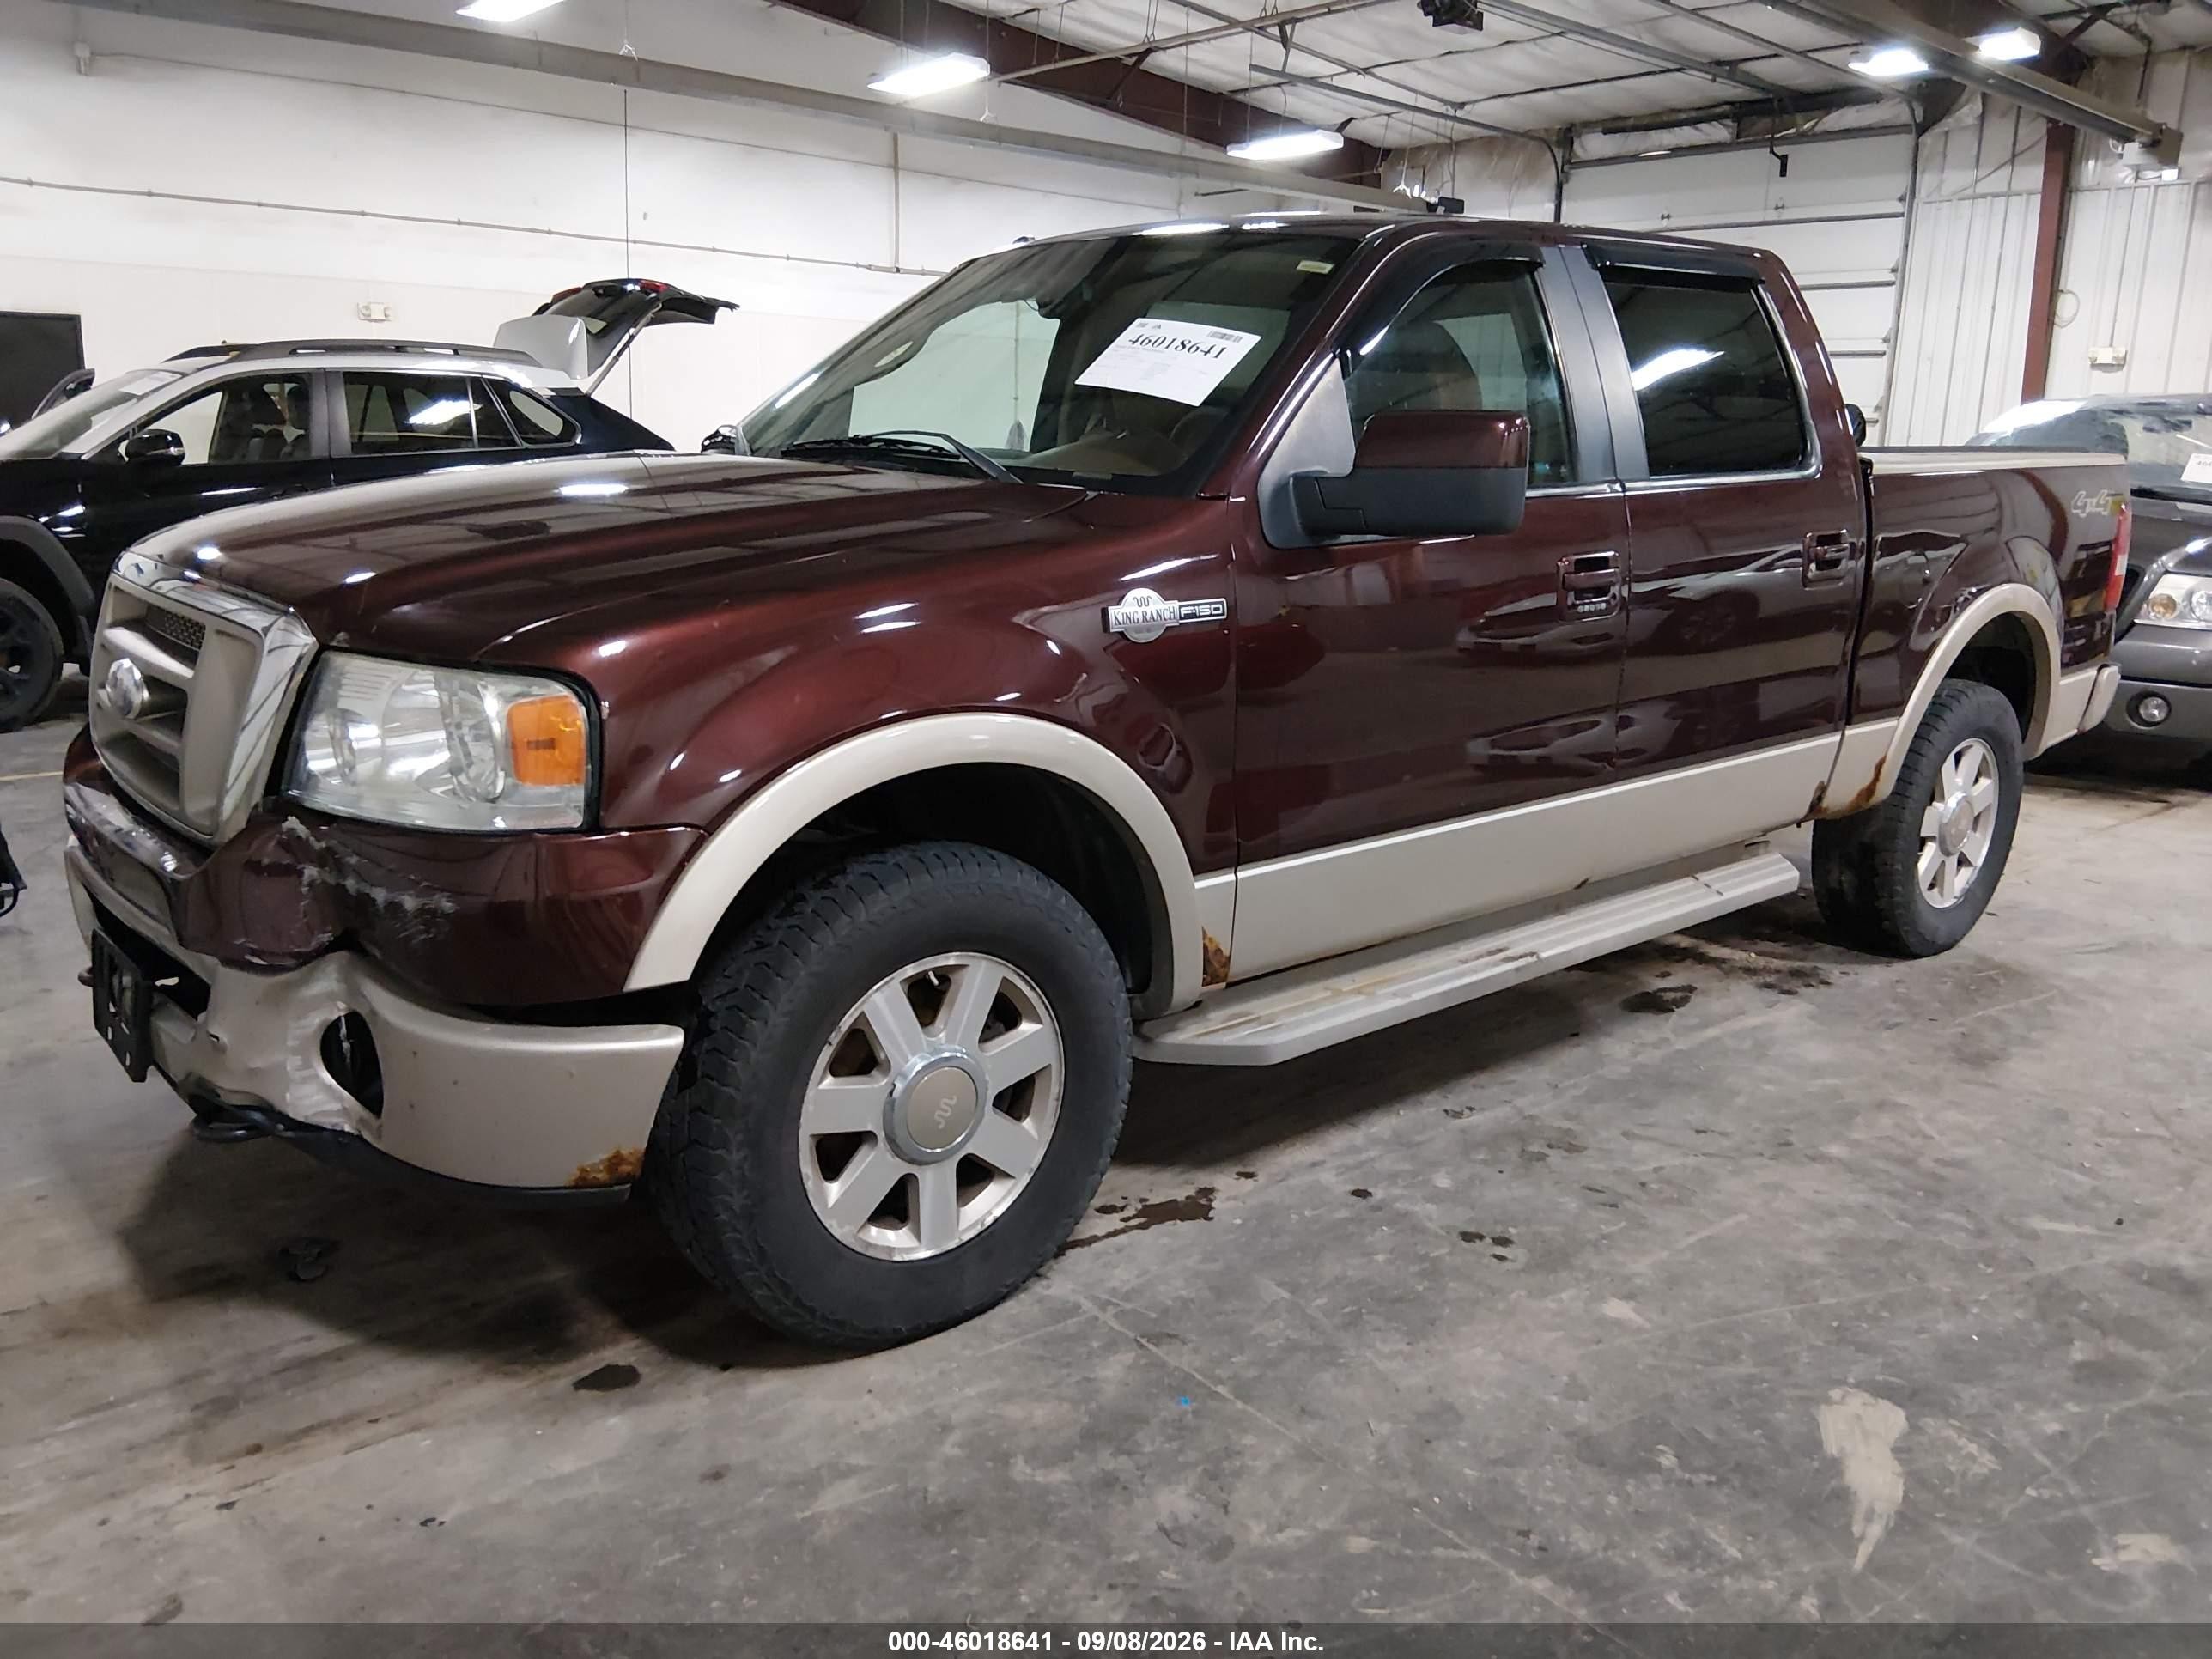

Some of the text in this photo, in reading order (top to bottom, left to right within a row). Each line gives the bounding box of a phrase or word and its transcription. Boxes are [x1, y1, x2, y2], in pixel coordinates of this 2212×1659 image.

[1128, 333, 1227, 359] 46018641
[1113, 611, 1140, 626] KING
[1142, 605, 1176, 623] RANCH
